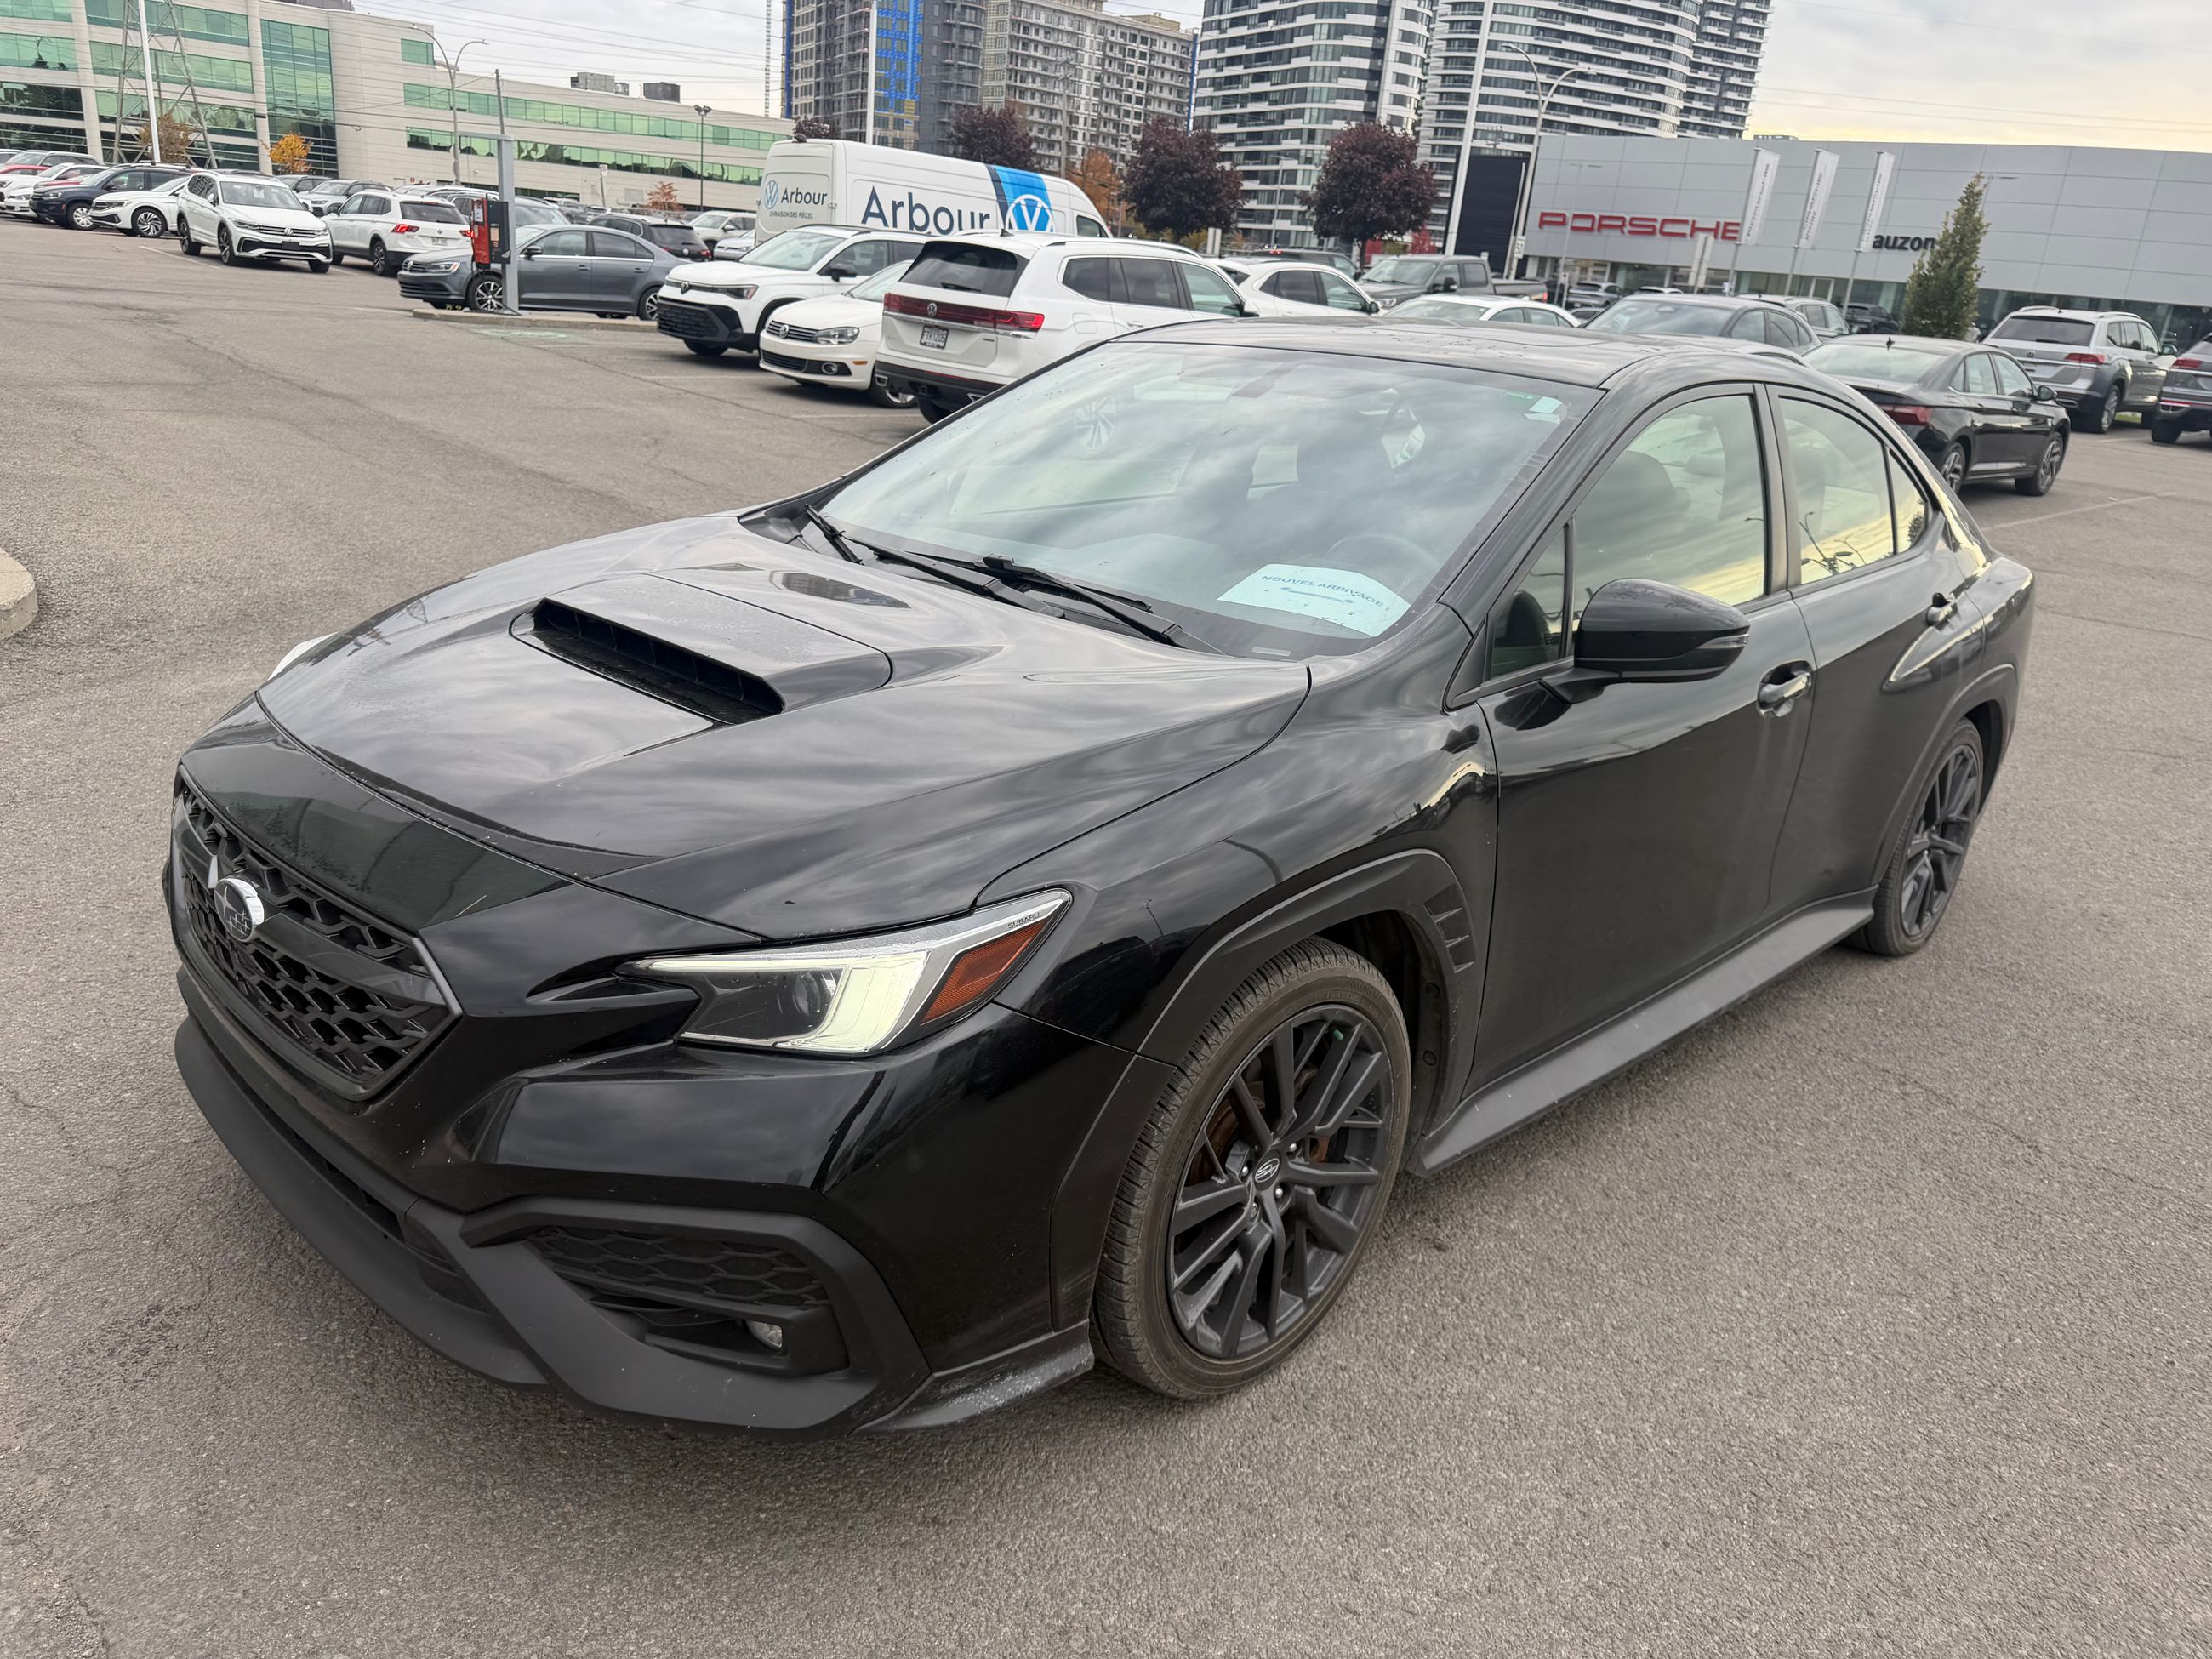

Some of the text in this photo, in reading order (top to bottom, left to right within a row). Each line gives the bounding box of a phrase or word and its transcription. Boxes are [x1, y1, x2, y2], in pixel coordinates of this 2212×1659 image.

[781, 187, 828, 205] Arbour
[861, 185, 990, 236] Arbour
[1538, 211, 1742, 242] PORSCHE
[1872, 234, 1936, 252] auzon
[1262, 575, 1315, 587] NOUVEL
[1319, 583, 1383, 607] ARRIVAGE
[1008, 912, 1040, 928] SUBARU
